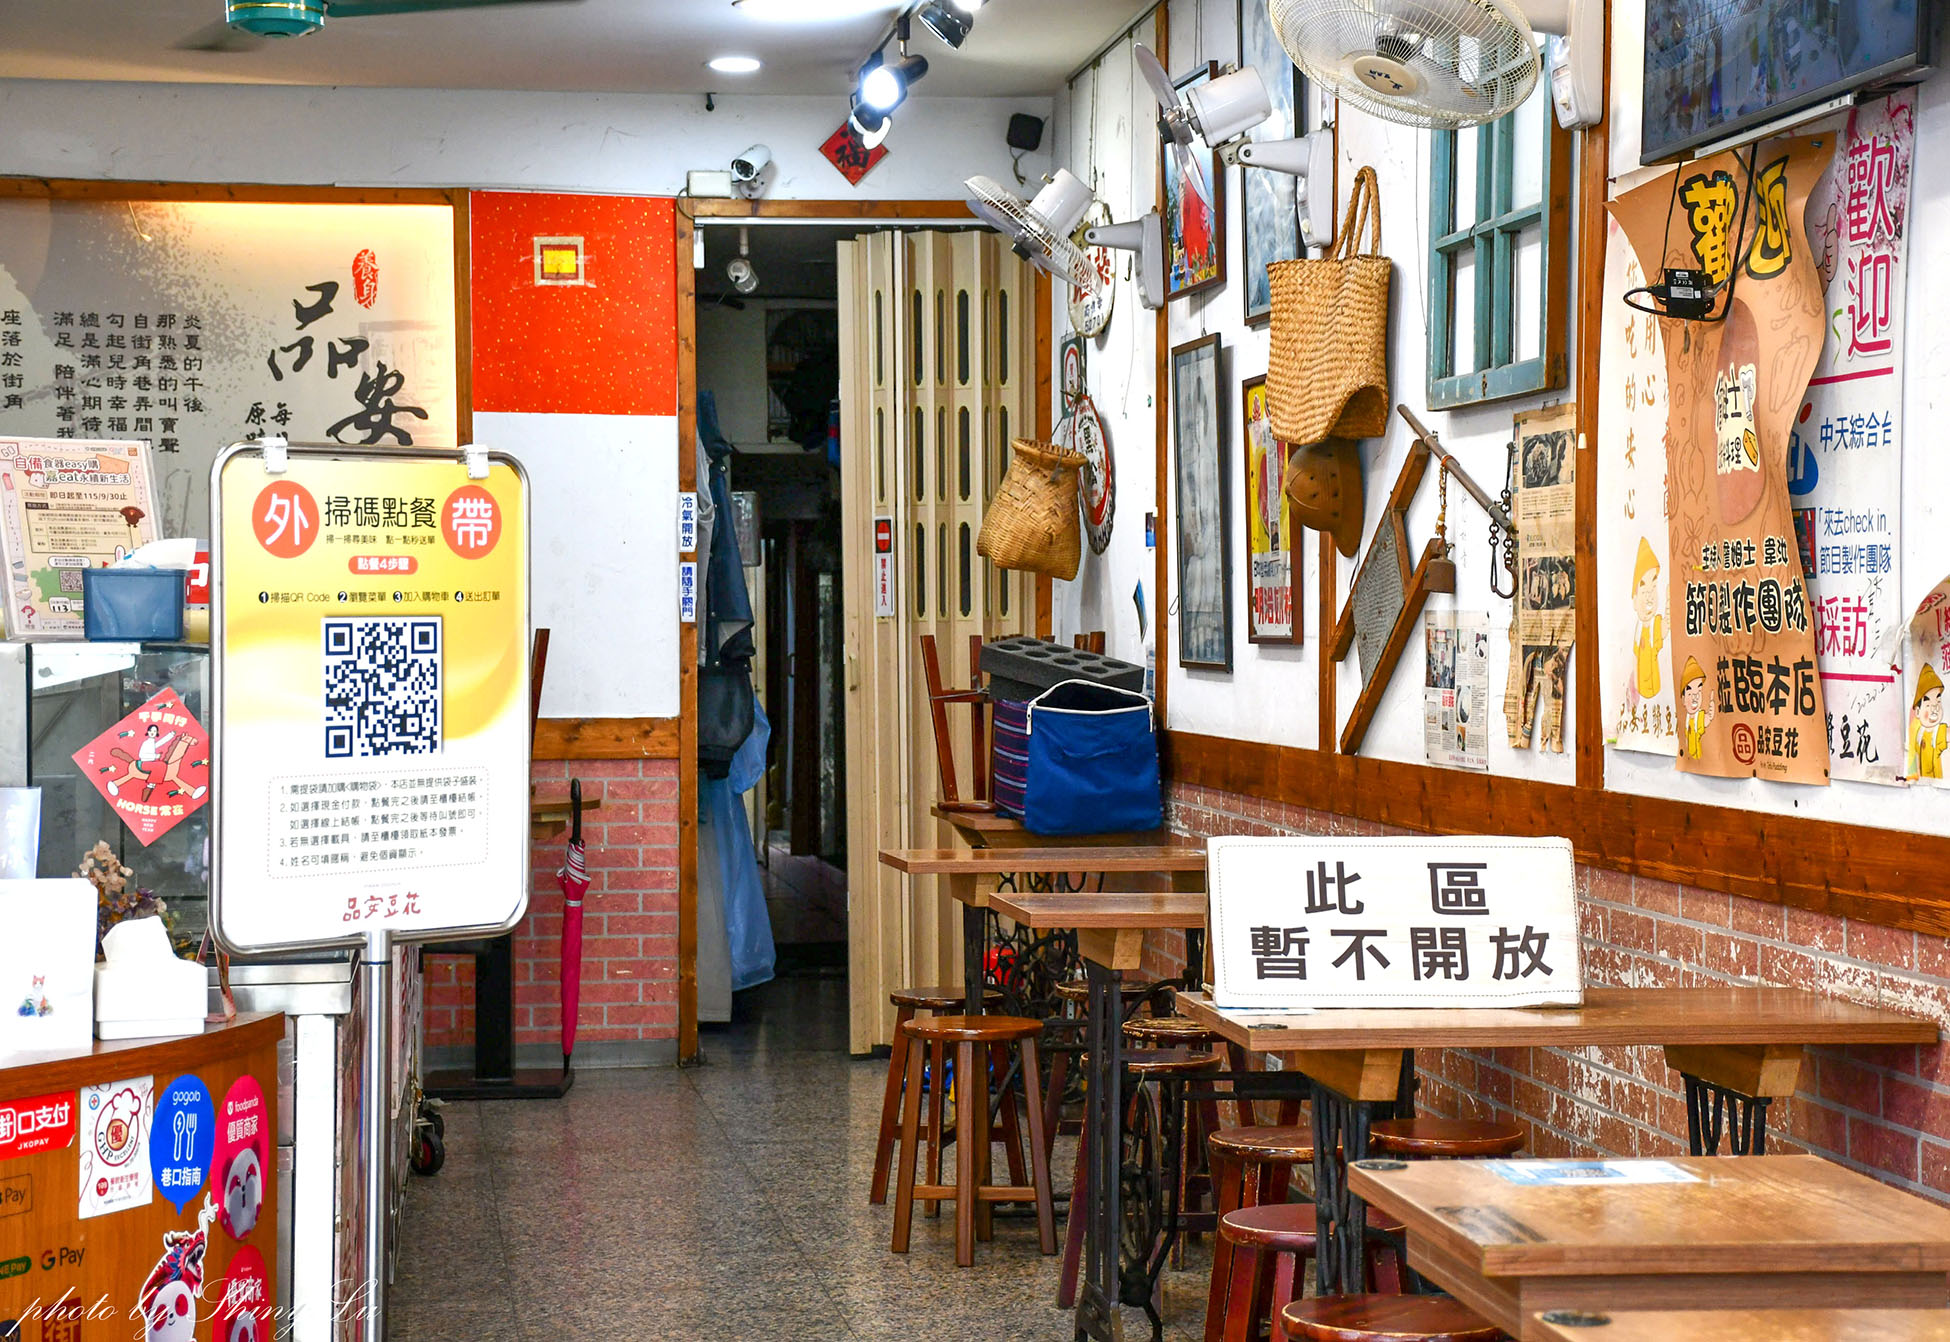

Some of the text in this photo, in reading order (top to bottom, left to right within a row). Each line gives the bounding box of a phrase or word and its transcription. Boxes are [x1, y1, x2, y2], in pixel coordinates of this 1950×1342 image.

[1848, 136, 1895, 360] 歡迎
[1, 310, 24, 409] 座落於街角
[80, 311, 102, 440] 總是滿心期待
[105, 313, 128, 440] 勾起兒時幸福
[183, 314, 204, 413] 炎夏的午後
[268, 281, 428, 446] 品安
[156, 313, 180, 453] 那熟悉的叫賣聲
[270, 402, 293, 441] 每
[50, 491, 127, 501] 即日起至115/9/30止
[325, 495, 437, 529] 掃碼點餐
[264, 493, 309, 546] 外
[452, 498, 493, 549] 帶
[681, 497, 693, 547] 冷氣開放
[326, 534, 436, 545] 掃一掃尋美味 點一點秒送單
[357, 558, 409, 571] 點餐4步驟
[1820, 544, 1892, 574] 節目製作團隊
[307, 591, 330, 603] Code
[1686, 578, 1808, 635] 節目製作團隊
[1811, 595, 1868, 658] 採訪
[1617, 703, 1678, 739] 品安豆漿豆
[1757, 725, 1799, 758] 品安豆花
[343, 891, 421, 921] 品安豆花
[1250, 925, 1554, 981] 暫不開放
[235, 1096, 259, 1113] foodpanda
[17, 1138, 49, 1151] JKOPAY
[227, 1115, 258, 1144] 優質商家
[161, 1166, 201, 1187] 巷口指南
[5, 1186, 26, 1204] Pay
[41, 1247, 85, 1271] G Pay
